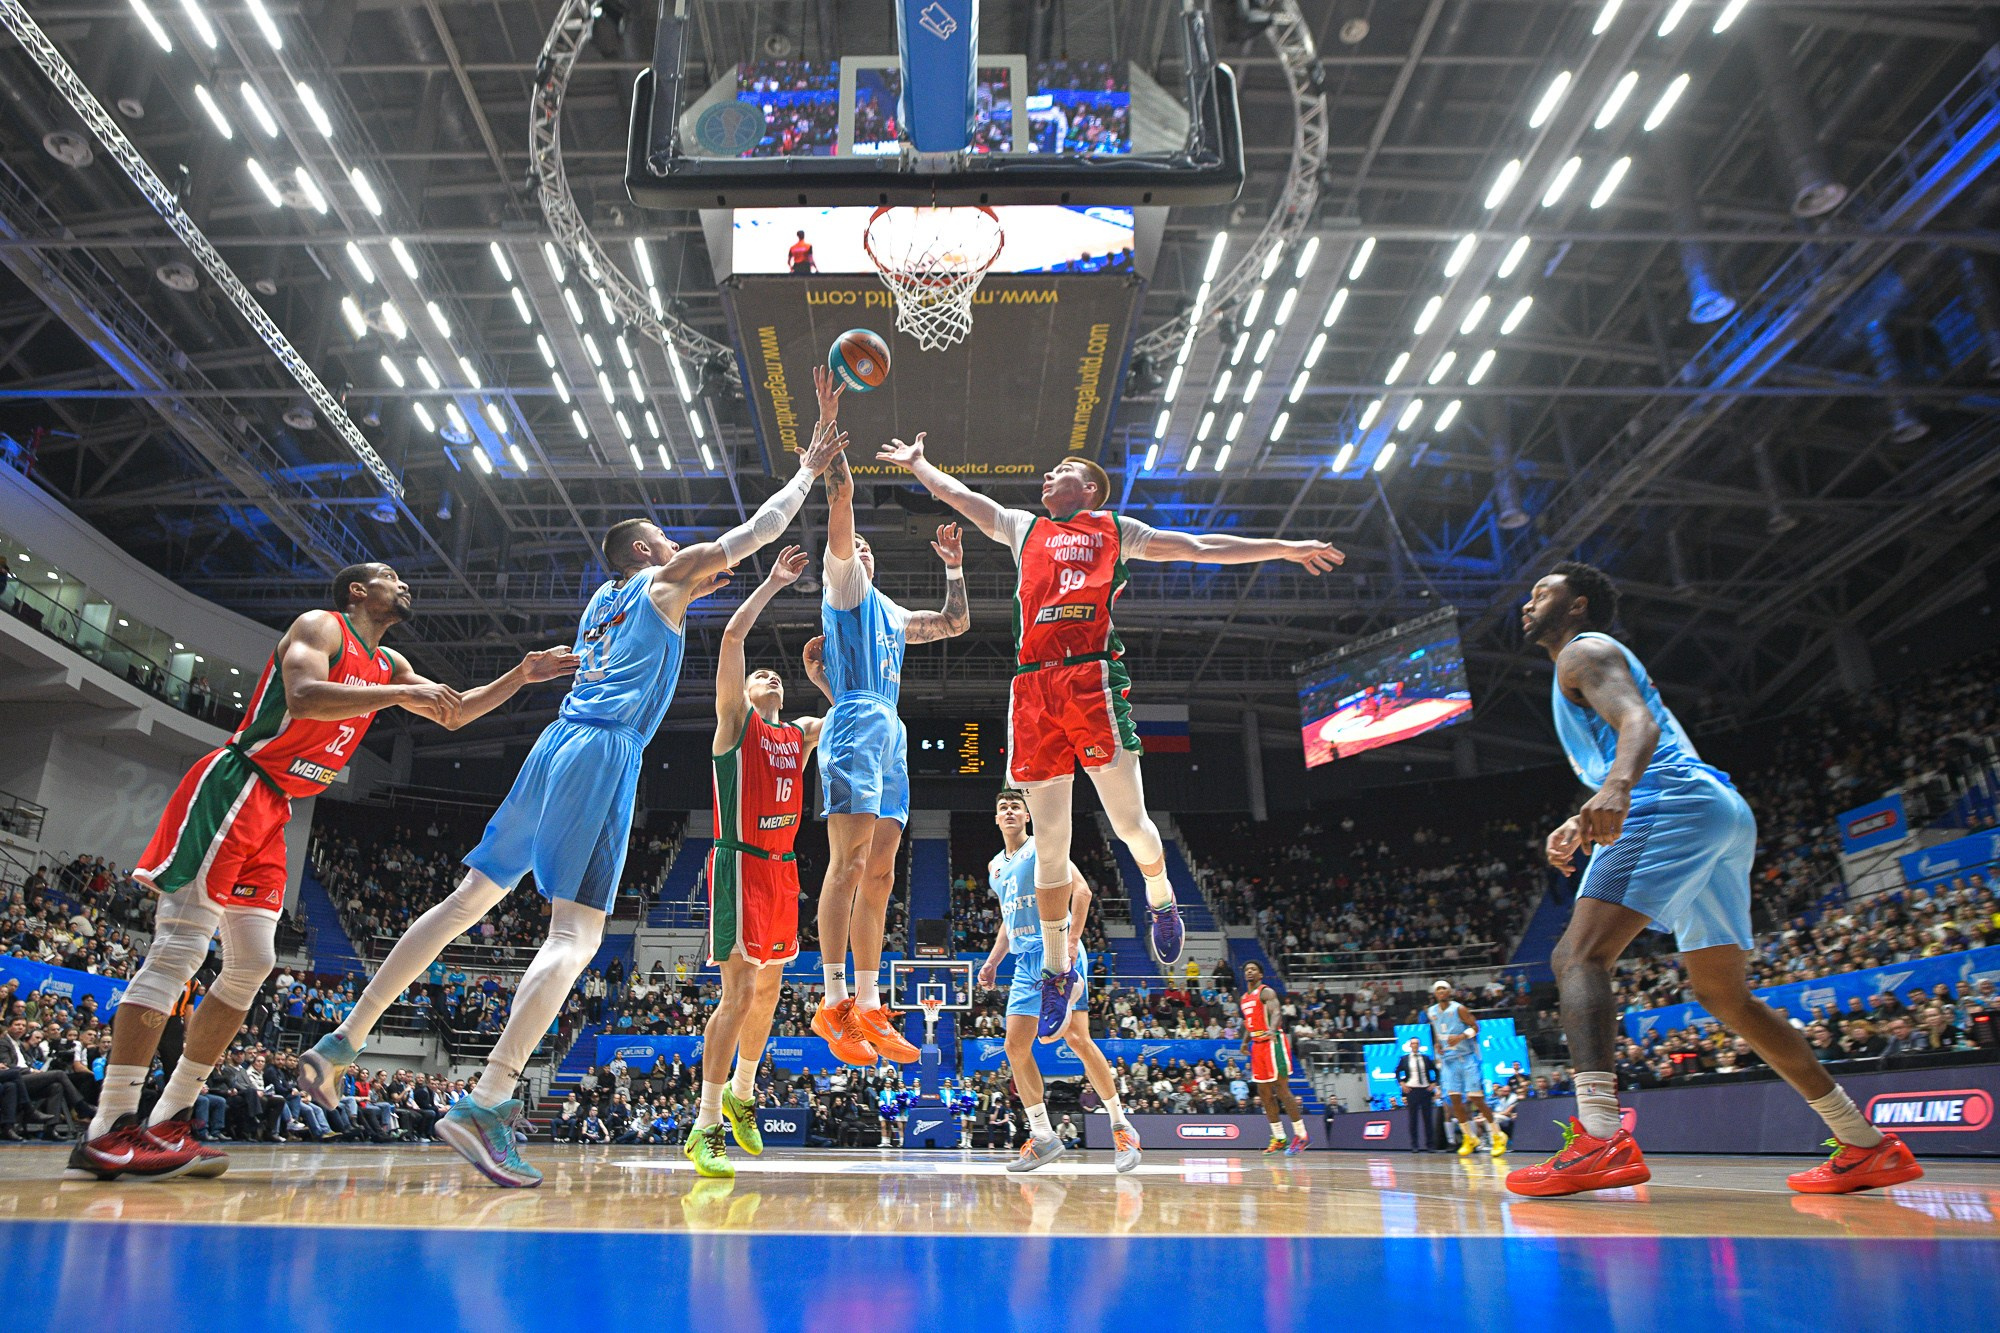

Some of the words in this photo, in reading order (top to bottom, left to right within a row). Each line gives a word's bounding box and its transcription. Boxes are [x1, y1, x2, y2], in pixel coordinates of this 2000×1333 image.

[807, 290, 1059, 308] www.mltd.com
[850, 463, 1035, 474] ww.mluxltd.com
[1054, 546, 1094, 562] KUBAN
[1059, 568, 1086, 595] 99
[775, 777, 793, 803] 16
[1874, 1100, 1964, 1124] WINLINE
